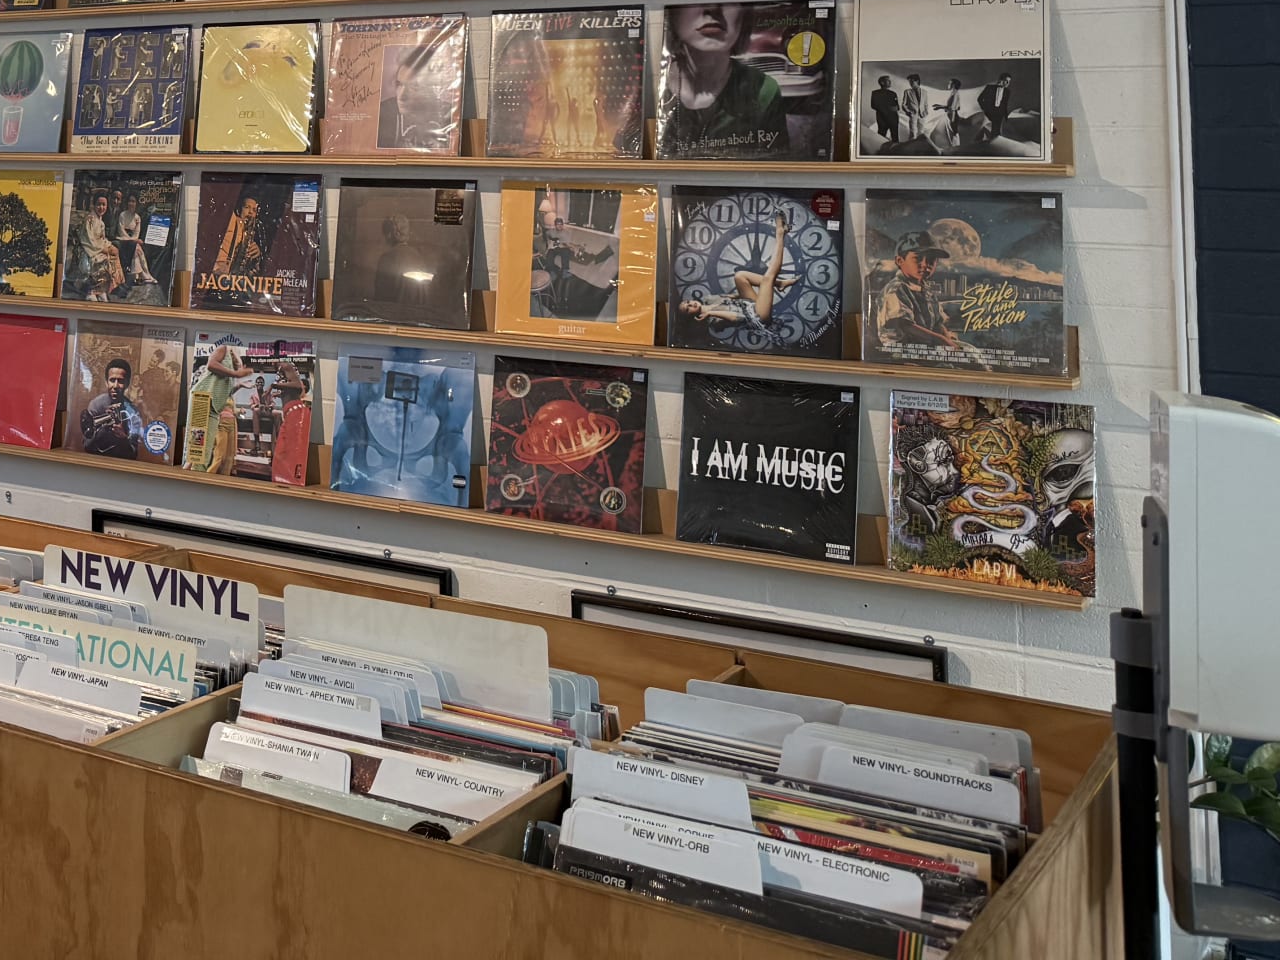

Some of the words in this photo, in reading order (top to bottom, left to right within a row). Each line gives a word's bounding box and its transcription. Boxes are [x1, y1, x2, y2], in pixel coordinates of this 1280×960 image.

[545, 16, 573, 33] LIVE
[579, 16, 642, 29] KILLERS
[1001, 49, 1041, 57] VIENNA
[80, 135, 94, 145] The
[95, 135, 110, 145] Best
[144, 135, 174, 145] PERKINS
[676, 140, 689, 151] It's
[700, 135, 726, 148] shame
[727, 130, 755, 145] about
[757, 129, 779, 149] Ray
[716, 203, 736, 223] 11
[746, 196, 772, 217] 12
[690, 228, 713, 247] 10
[808, 231, 822, 251] 2
[276, 269, 297, 278] JACKIE
[683, 257, 697, 277] 9
[818, 264, 831, 283] 3
[196, 272, 283, 296] JACKNIFE
[282, 277, 308, 288] McLEAN
[805, 296, 820, 316] 4
[960, 281, 1014, 311] Style
[558, 324, 587, 336] guitar
[782, 318, 796, 339] 5
[961, 308, 1028, 334] Passion
[195, 346, 208, 357] it's
[214, 332, 244, 347] mother
[246, 341, 275, 357] JAMES
[689, 436, 700, 477] I
[705, 440, 749, 483] AM
[755, 443, 845, 494] MUSIC
[60, 548, 136, 595] NEW
[144, 563, 250, 622] VINYL
[9, 601, 22, 609] NEW
[53, 610, 79, 620] BRYAN
[42, 591, 57, 600] NEW
[74, 598, 94, 609] JASON
[93, 602, 113, 613] ISBELL
[39, 636, 59, 647] TENG
[138, 625, 152, 635] NEW
[174, 633, 207, 647] COUNTRY
[321, 654, 338, 665] NEW
[50, 666, 67, 677] NEW
[66, 670, 110, 688] VINYL-JAPAN
[289, 669, 307, 680] NEW
[309, 672, 329, 685] VINYL
[333, 679, 355, 691] AVICII
[264, 680, 282, 691] NEW
[282, 683, 304, 697] VINYL
[308, 688, 335, 703] APHEX
[334, 694, 356, 708] TWIN
[415, 767, 435, 780] NEW
[463, 779, 505, 799] COUNTRY
[616, 760, 639, 773] NEW
[669, 771, 706, 788] DISNEY
[852, 754, 877, 768] NEW
[912, 766, 994, 793] SOUNDTRACKS
[632, 826, 656, 841] NEW
[656, 831, 711, 855] VINYL-ORB
[757, 840, 782, 856] NEW
[783, 846, 815, 864] VINYL
[821, 855, 891, 883] ELECTRONIC
